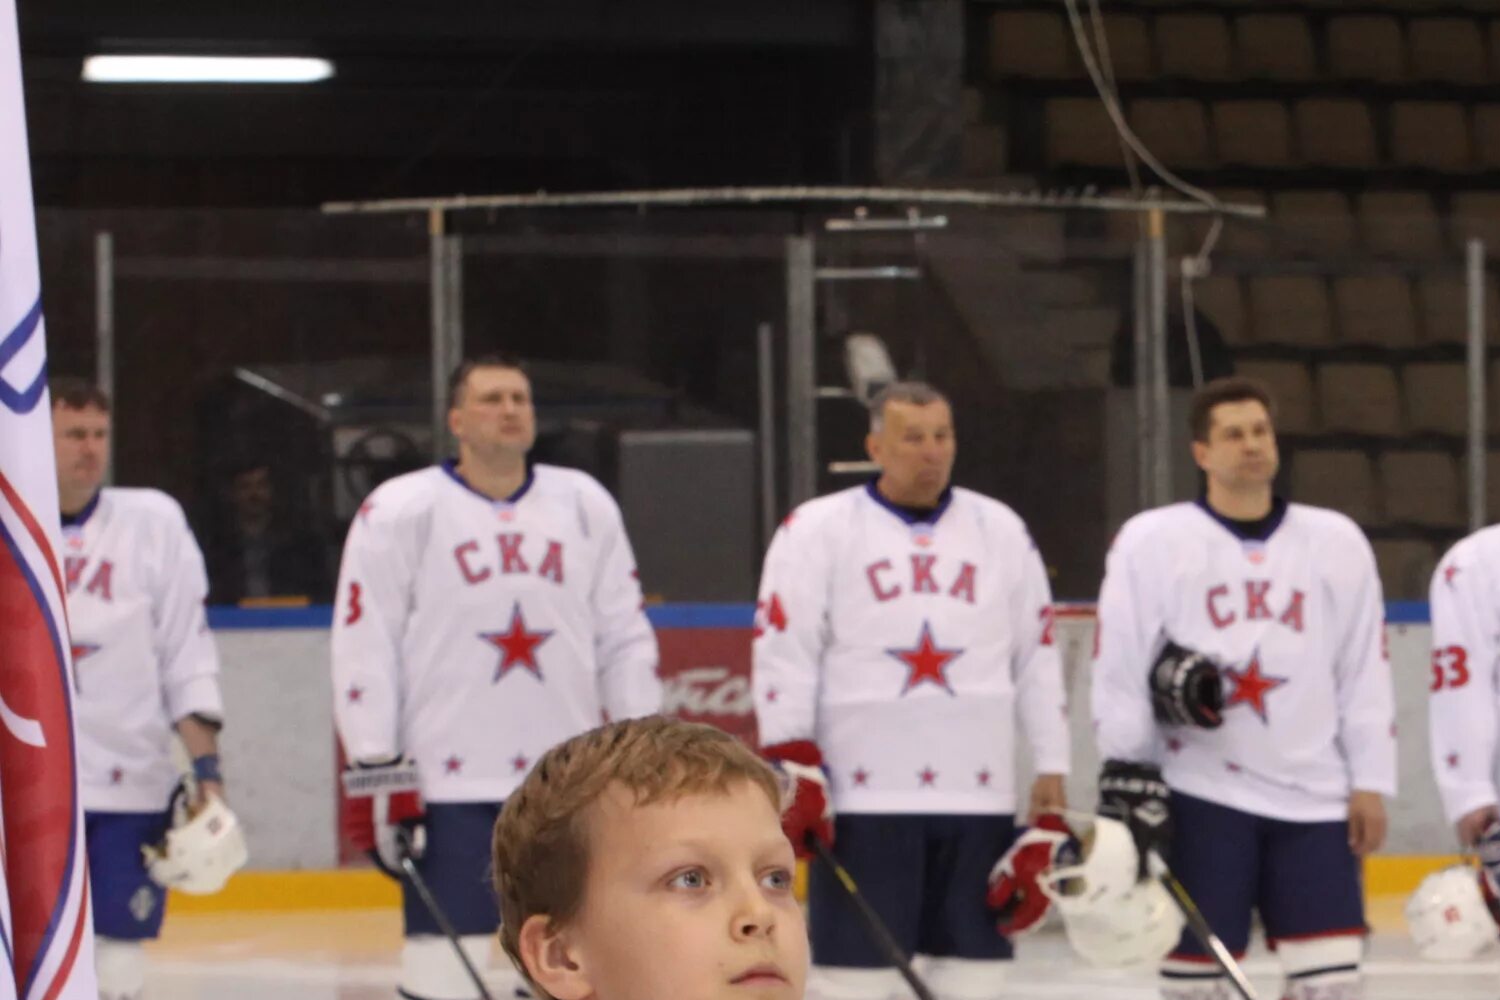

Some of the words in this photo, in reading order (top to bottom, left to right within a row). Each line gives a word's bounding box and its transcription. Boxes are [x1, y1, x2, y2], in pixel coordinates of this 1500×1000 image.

[454, 533, 563, 584] СКА
[866, 554, 976, 604] СКА
[1206, 581, 1305, 632] СКА
